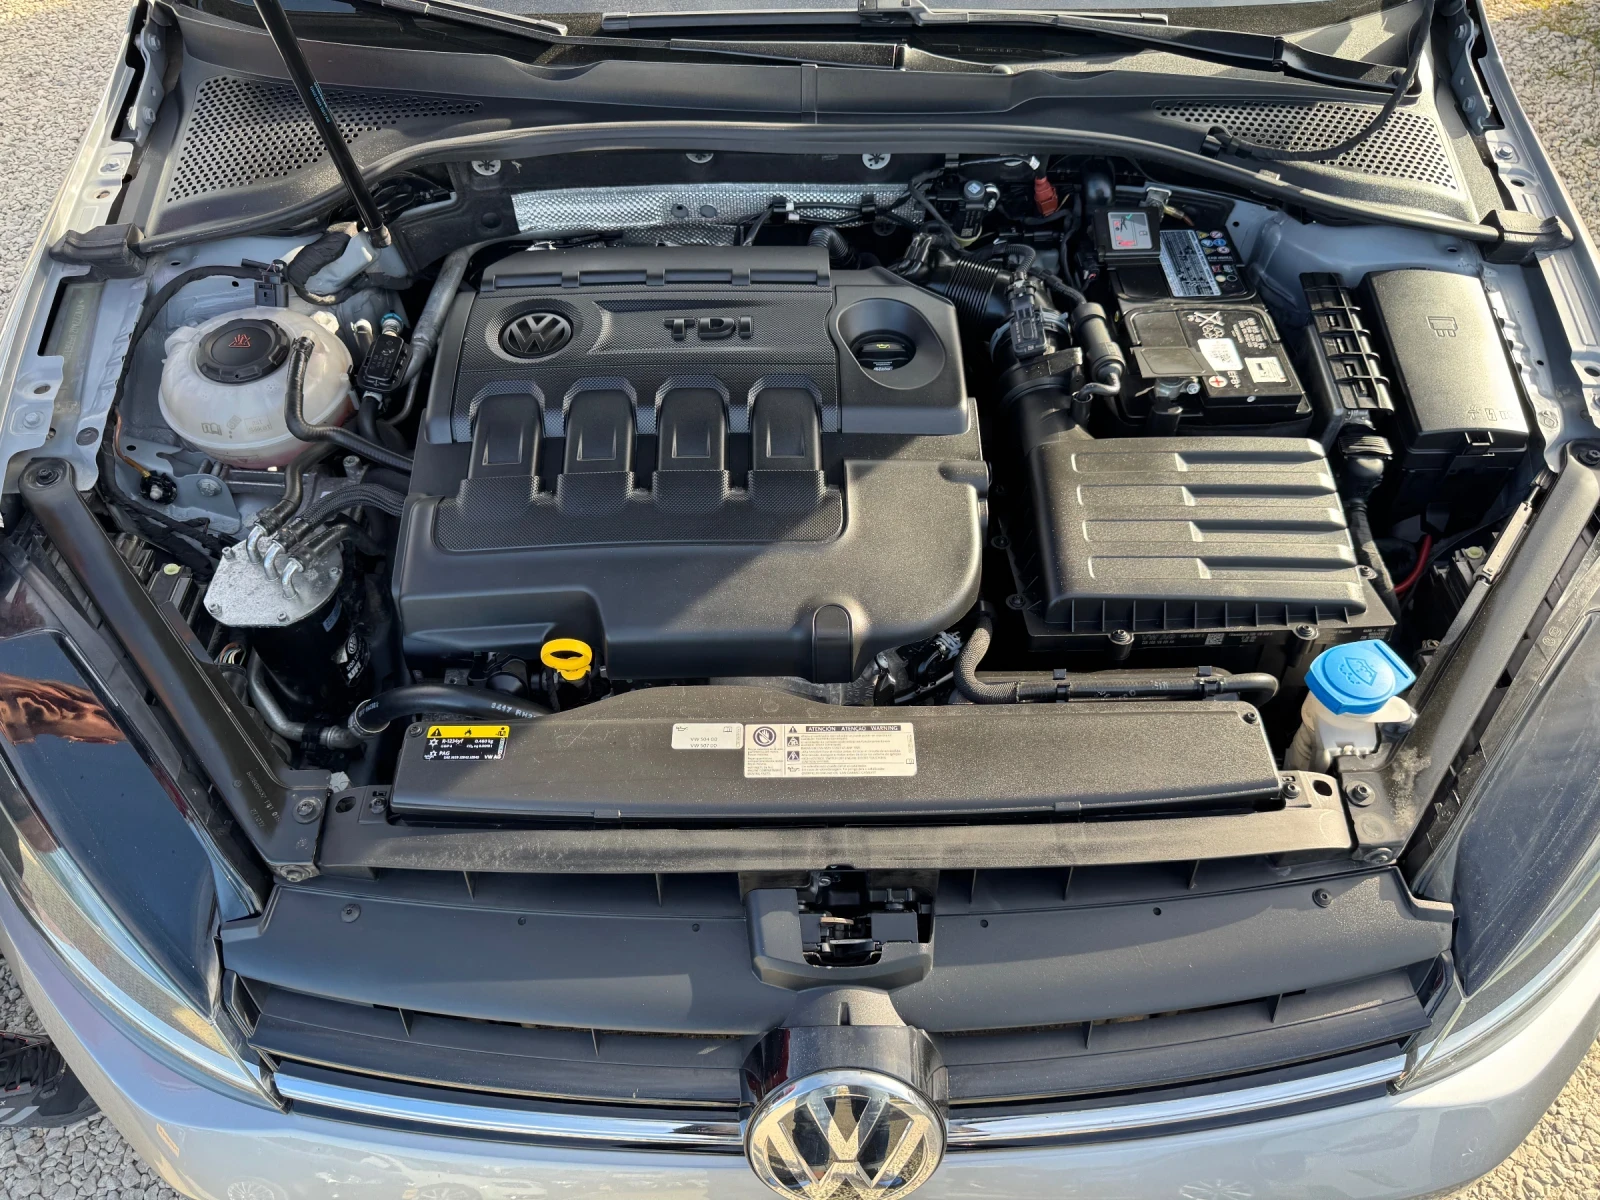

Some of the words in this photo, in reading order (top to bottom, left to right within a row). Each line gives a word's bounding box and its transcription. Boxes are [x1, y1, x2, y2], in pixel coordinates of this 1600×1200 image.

[500, 311, 574, 356] VW
[662, 315, 754, 340] TDI
[347, 661, 362, 680] UFI
